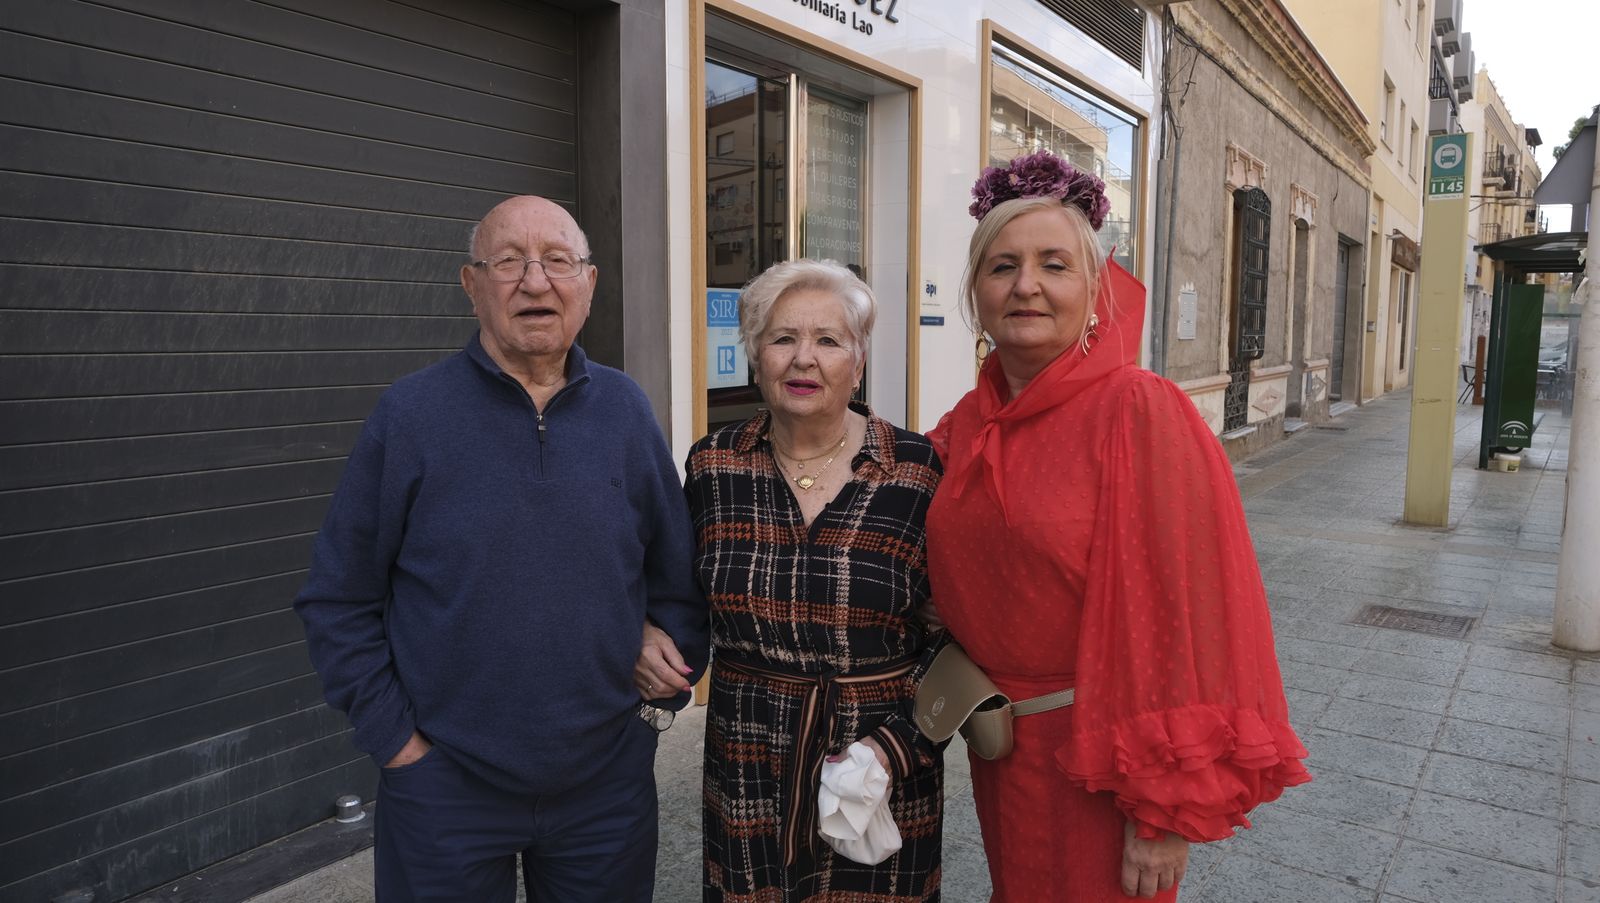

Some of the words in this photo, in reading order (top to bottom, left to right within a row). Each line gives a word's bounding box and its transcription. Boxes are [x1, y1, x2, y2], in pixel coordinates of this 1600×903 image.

[854, 0, 899, 23] EZ
[852, 11, 873, 36] Lao
[812, 148, 857, 168] ERENCIAS
[812, 169, 857, 188] QUILERES
[1431, 181, 1464, 193] 1145
